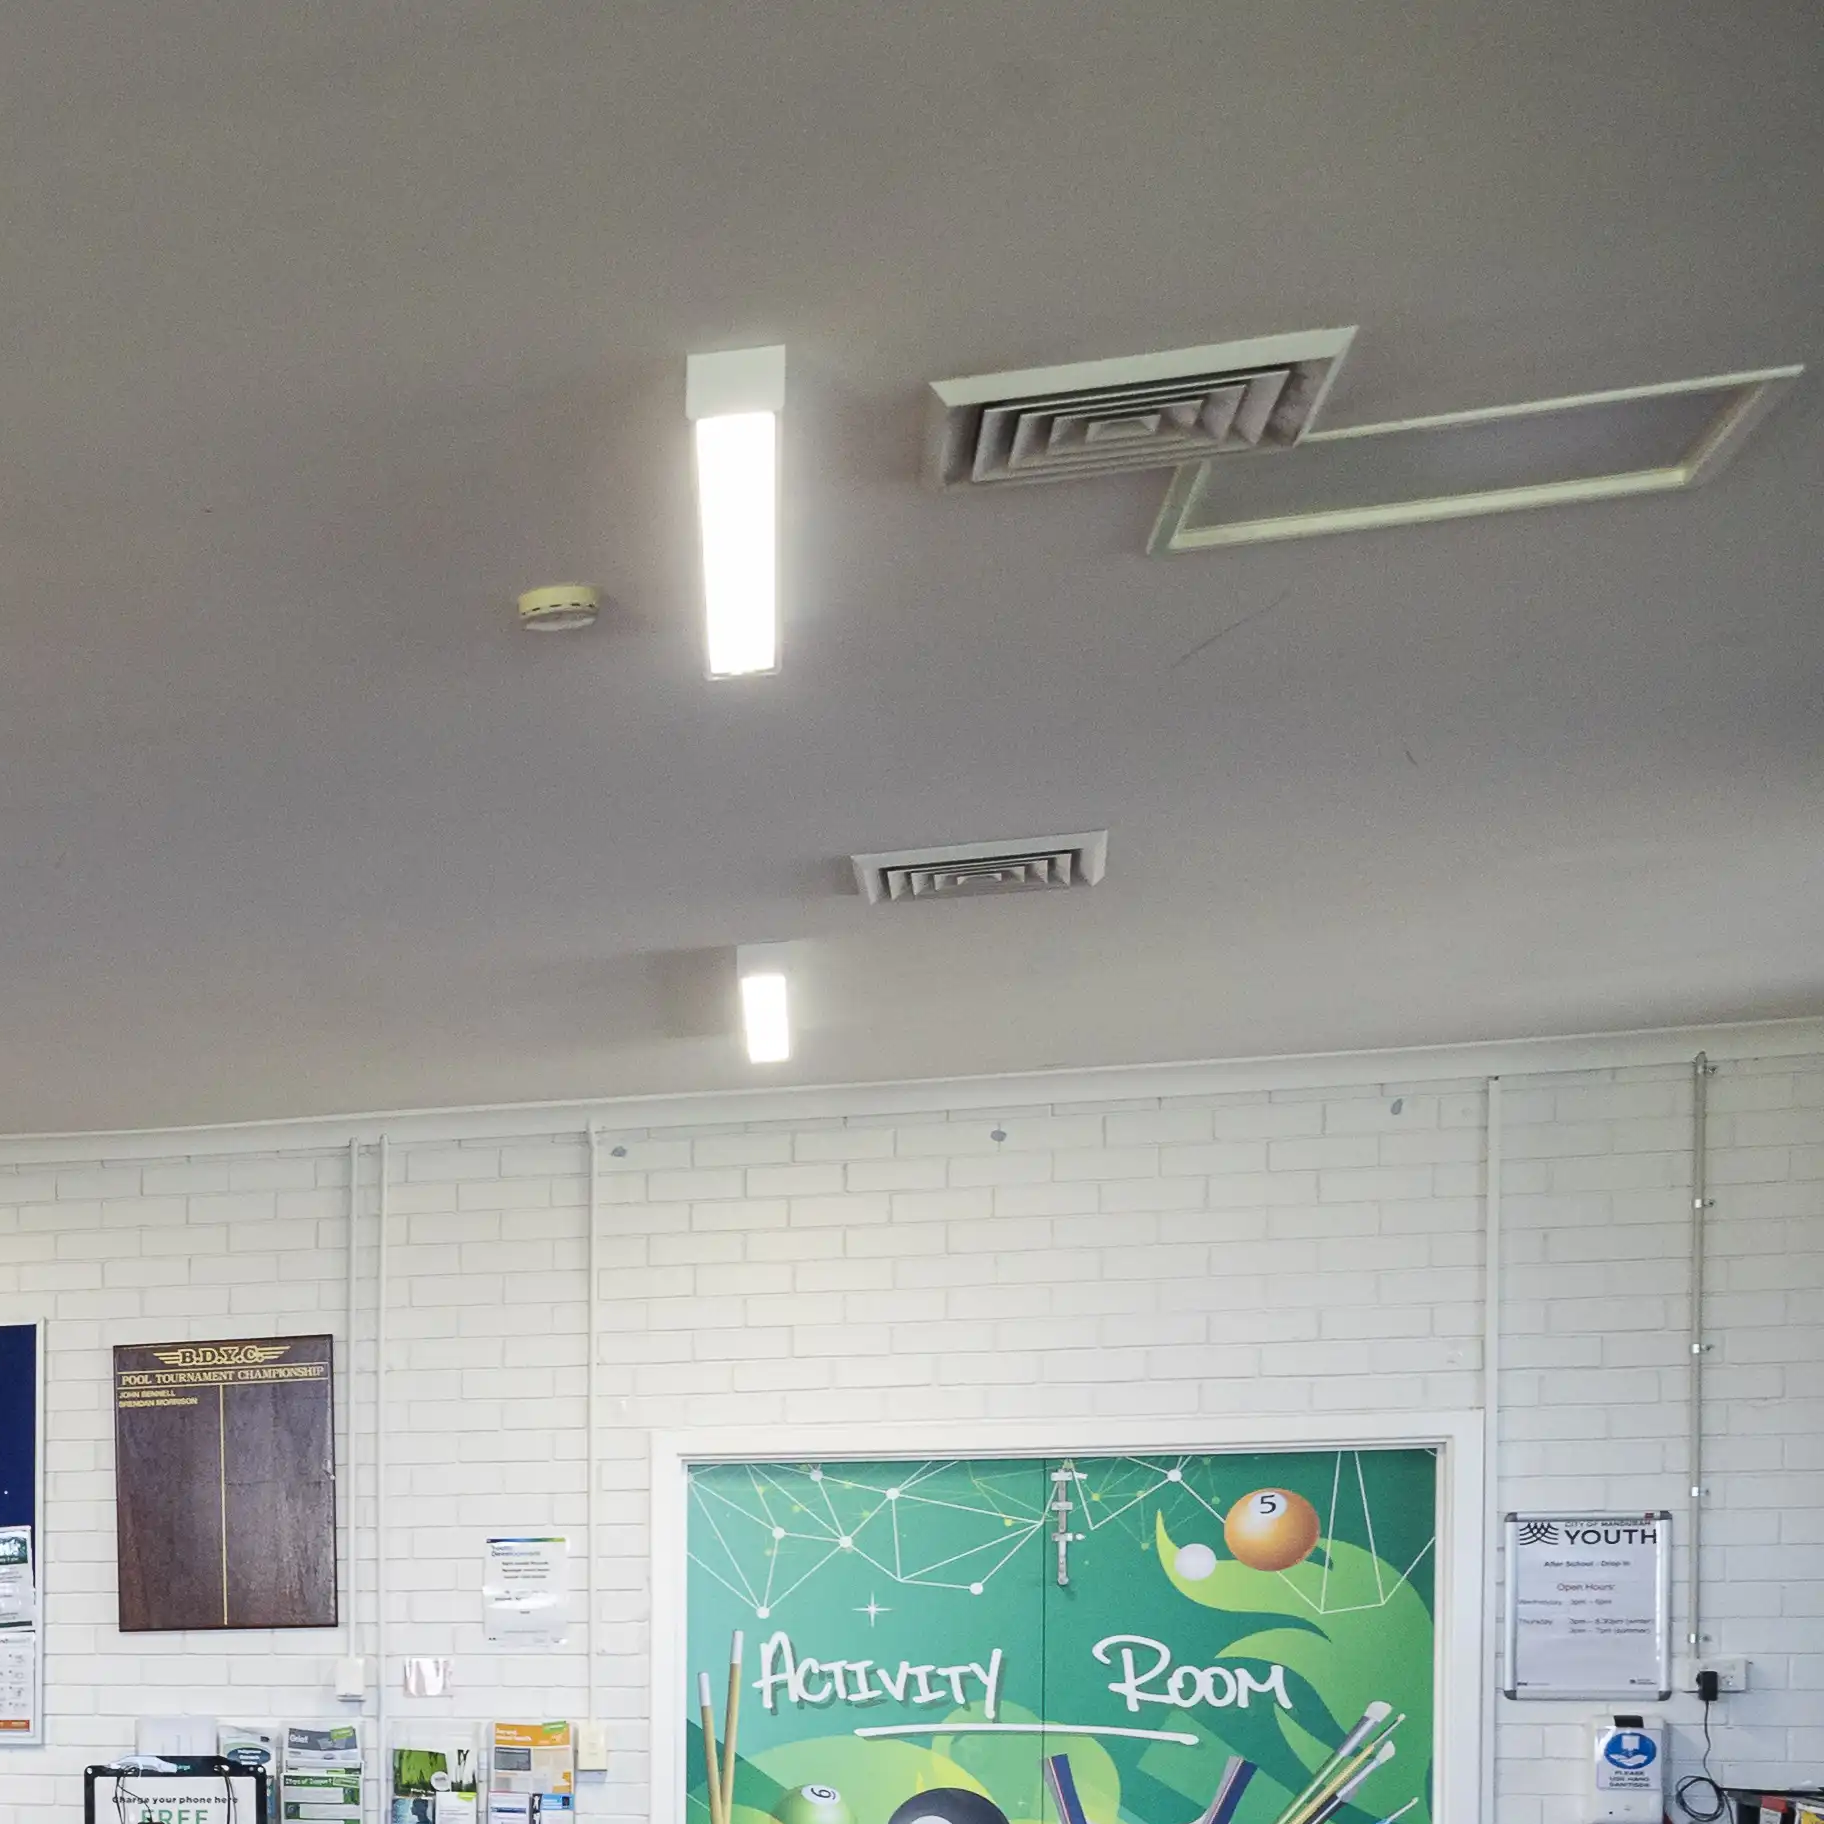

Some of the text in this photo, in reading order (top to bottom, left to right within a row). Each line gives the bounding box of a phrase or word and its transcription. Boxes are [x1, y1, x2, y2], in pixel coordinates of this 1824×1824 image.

[180, 1346, 263, 1365] B.D.Y.C.
[121, 1366, 326, 1387] POOL TOURNAMENT CHAMPIONSHIP
[118, 1390, 141, 1399] JOHN
[118, 1397, 199, 1409] BRENDAN MORRISON
[1259, 1494, 1277, 1515] 5
[1564, 1529, 1657, 1545] YOUTH
[1600, 1560, 1622, 1568] Drop
[1556, 1583, 1584, 1592] Open
[1517, 1618, 1554, 1626] Thursday
[289, 1734, 309, 1744] Grief
[112, 1795, 150, 1806] Charge
[152, 1796, 177, 1807] your
[179, 1796, 212, 1807] phone
